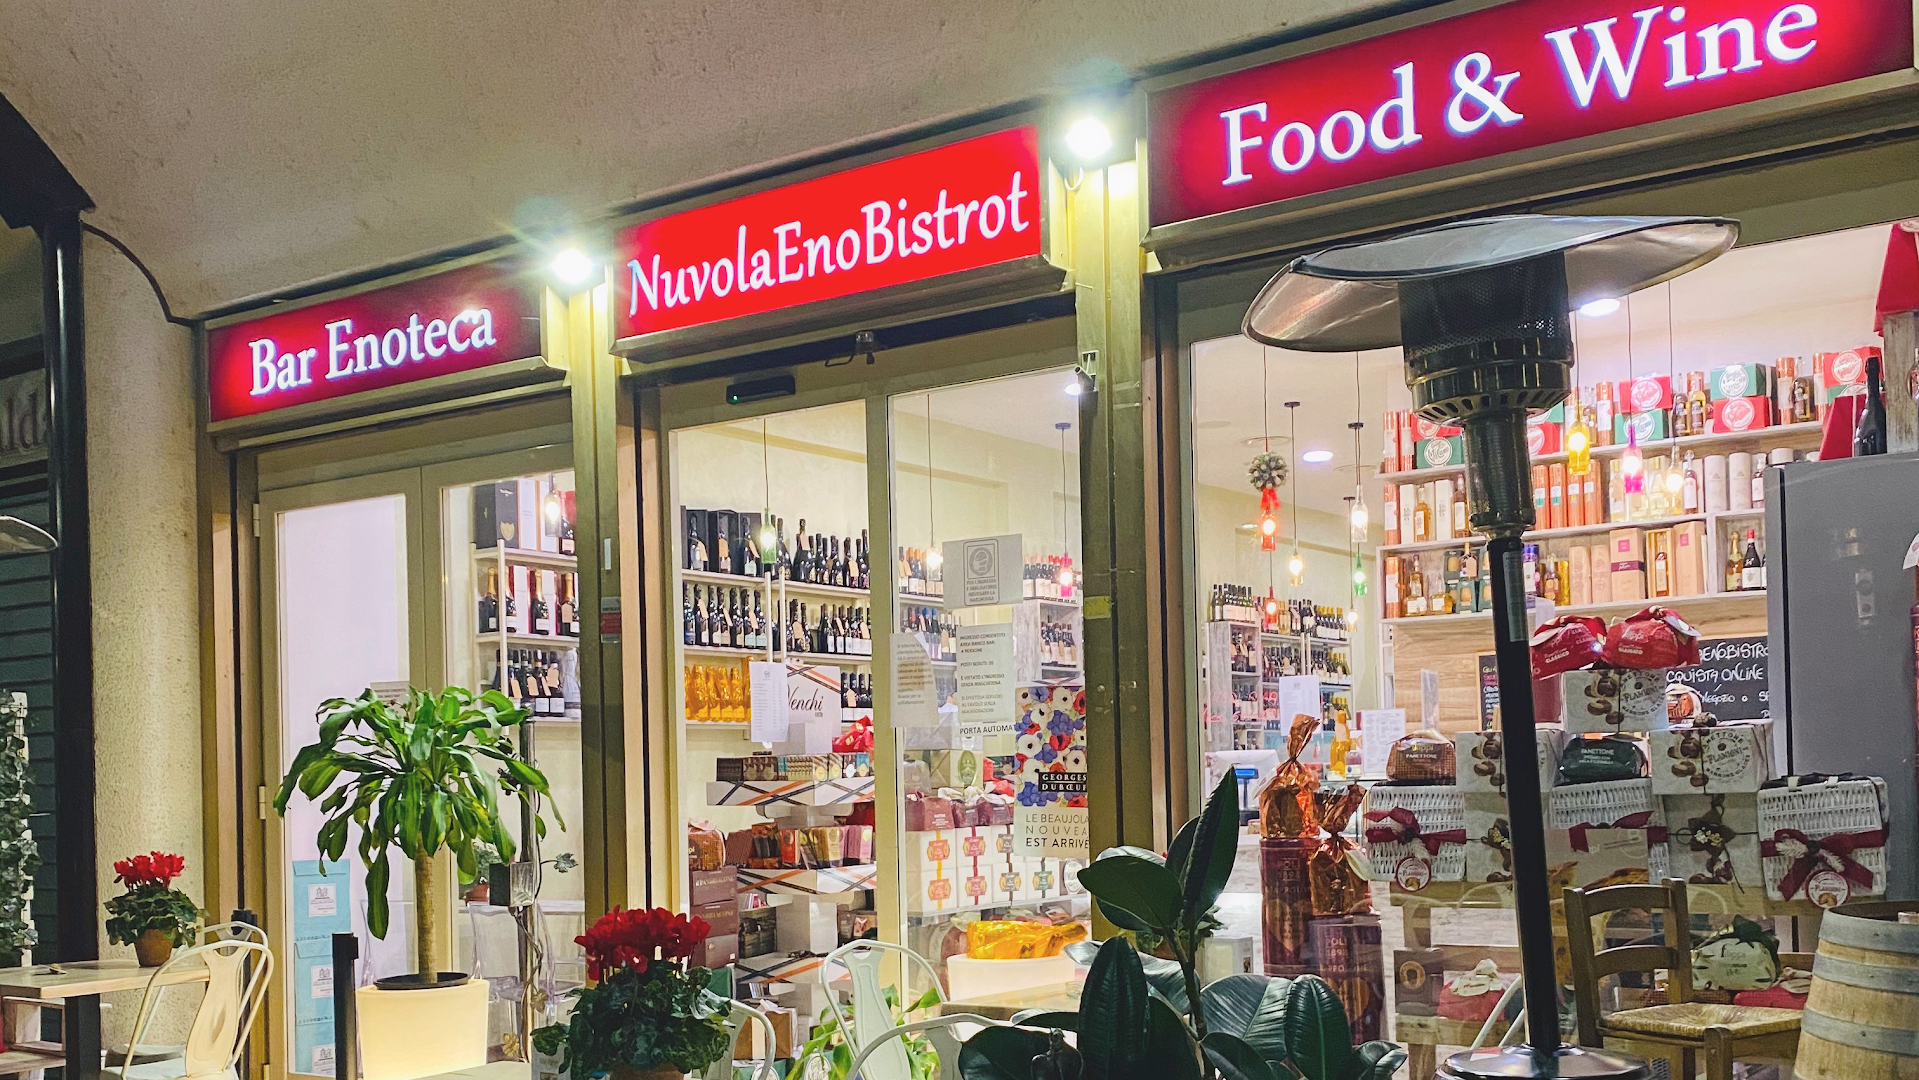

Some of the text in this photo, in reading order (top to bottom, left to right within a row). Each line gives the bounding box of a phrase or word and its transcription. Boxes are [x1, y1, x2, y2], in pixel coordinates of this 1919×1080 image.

[1220, 3, 1819, 186] Food & Wine
[626, 169, 1030, 318] NuvolaEnoBistrot
[248, 307, 498, 396] Bar Enoteca
[787, 684, 824, 712] Venchi
[960, 724, 1015, 735] PORTA AUTOMA
[1042, 773, 1087, 781] GEORGES
[1025, 813, 1038, 823] LE
[1025, 837, 1048, 847] EST
[1051, 837, 1089, 849] ARRIVÉ
